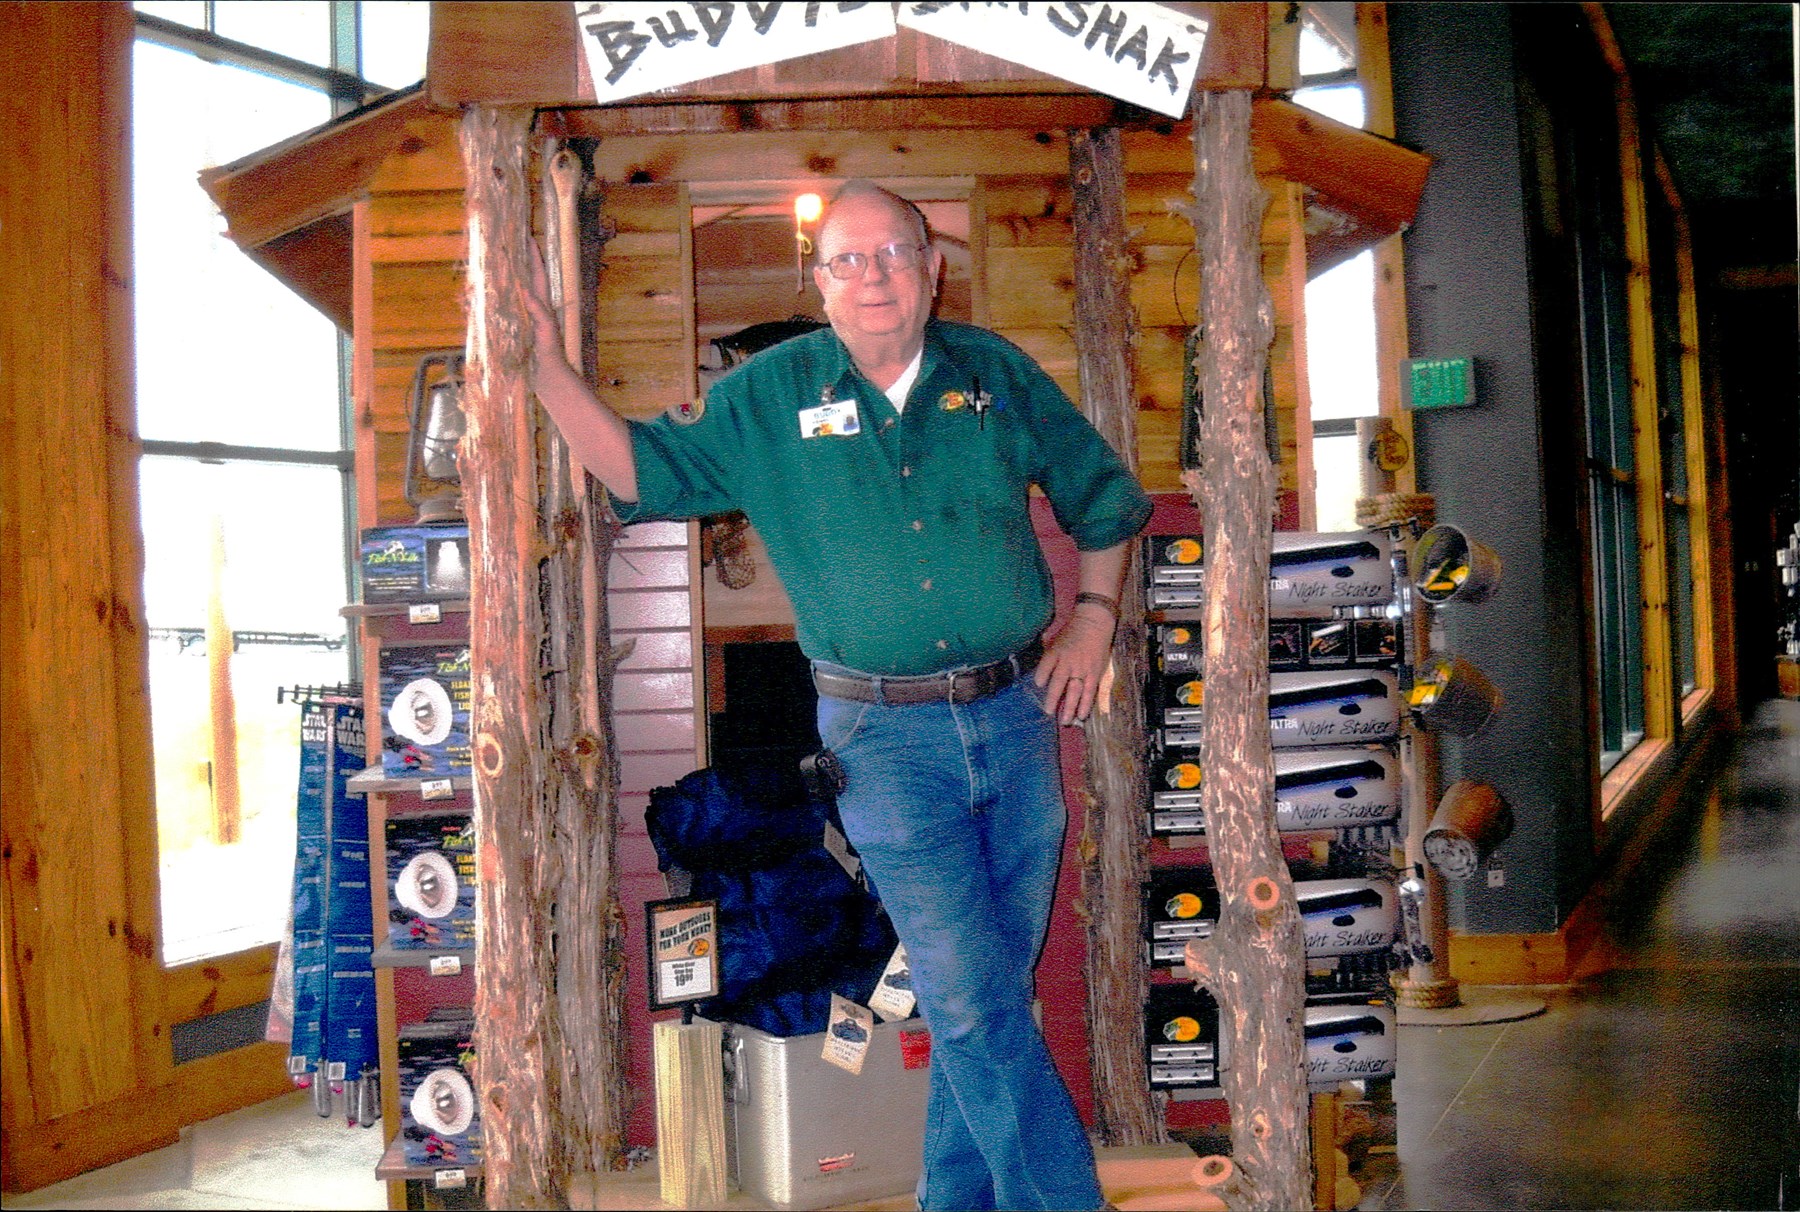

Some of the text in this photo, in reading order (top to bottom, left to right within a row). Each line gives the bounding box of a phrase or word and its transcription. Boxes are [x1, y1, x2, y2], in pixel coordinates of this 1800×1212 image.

[1047, 1, 1191, 96] SHAK
[1288, 582, 1328, 604] Night
[1331, 580, 1383, 598] Stalker
[1166, 653, 1188, 661] ULTRA
[302, 713, 327, 728] STAR
[336, 715, 366, 732] STA
[302, 729, 327, 742] WARS
[336, 730, 366, 748] WAR
[1298, 720, 1336, 742] Night
[1340, 719, 1392, 735] Stalker
[1292, 804, 1330, 826] Night
[1335, 802, 1389, 818] Stalker
[1333, 930, 1384, 946] Stalker
[1333, 1057, 1389, 1073] Stalker
